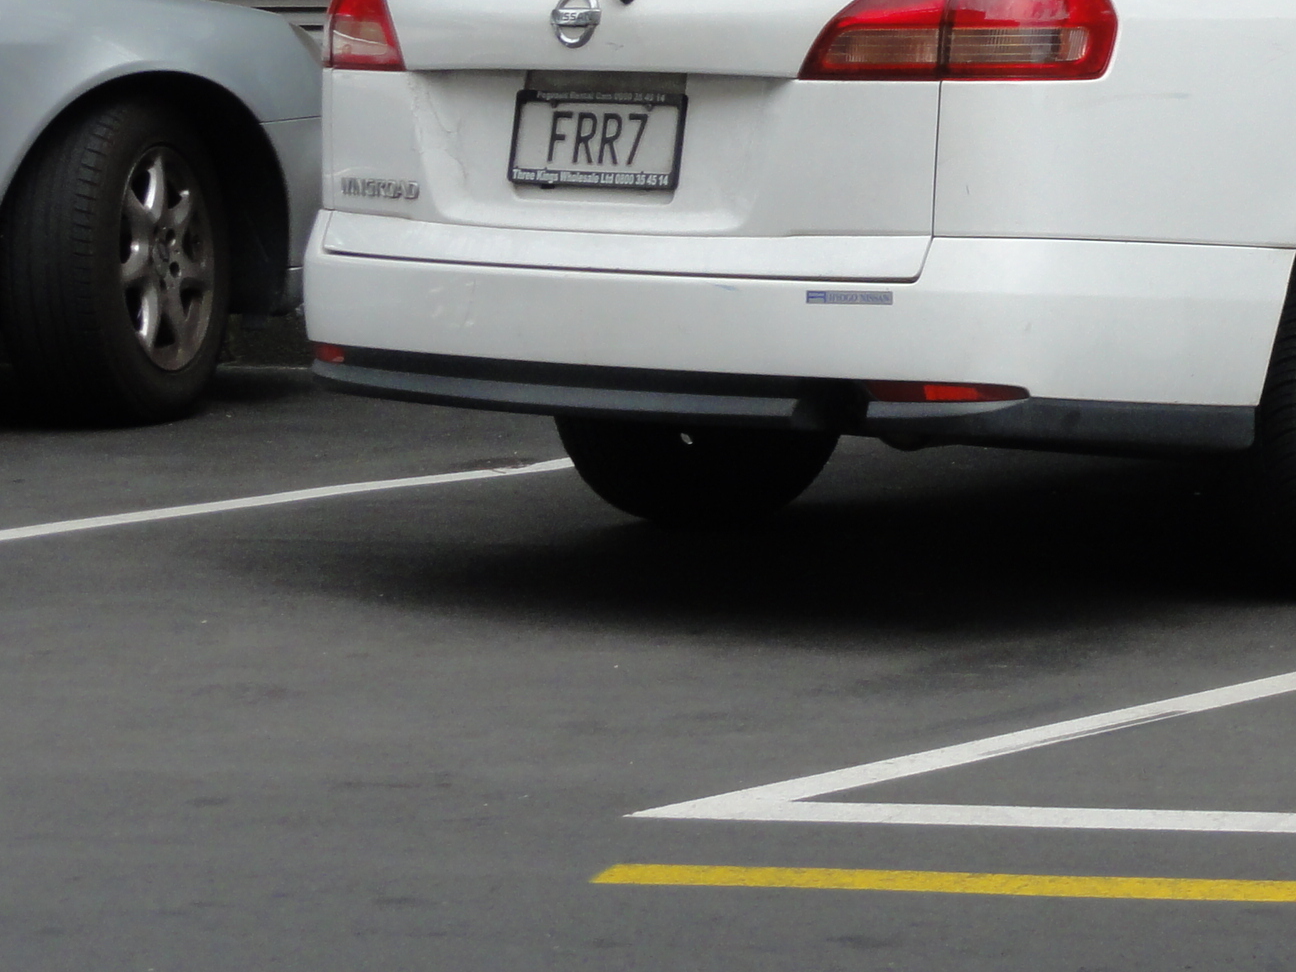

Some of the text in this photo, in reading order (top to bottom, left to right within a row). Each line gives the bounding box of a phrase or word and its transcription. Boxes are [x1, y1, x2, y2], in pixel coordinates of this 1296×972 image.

[547, 111, 649, 166] FRR7
[513, 169, 669, 185] Three Kings Wholesale Ltd 0800 35 45 14
